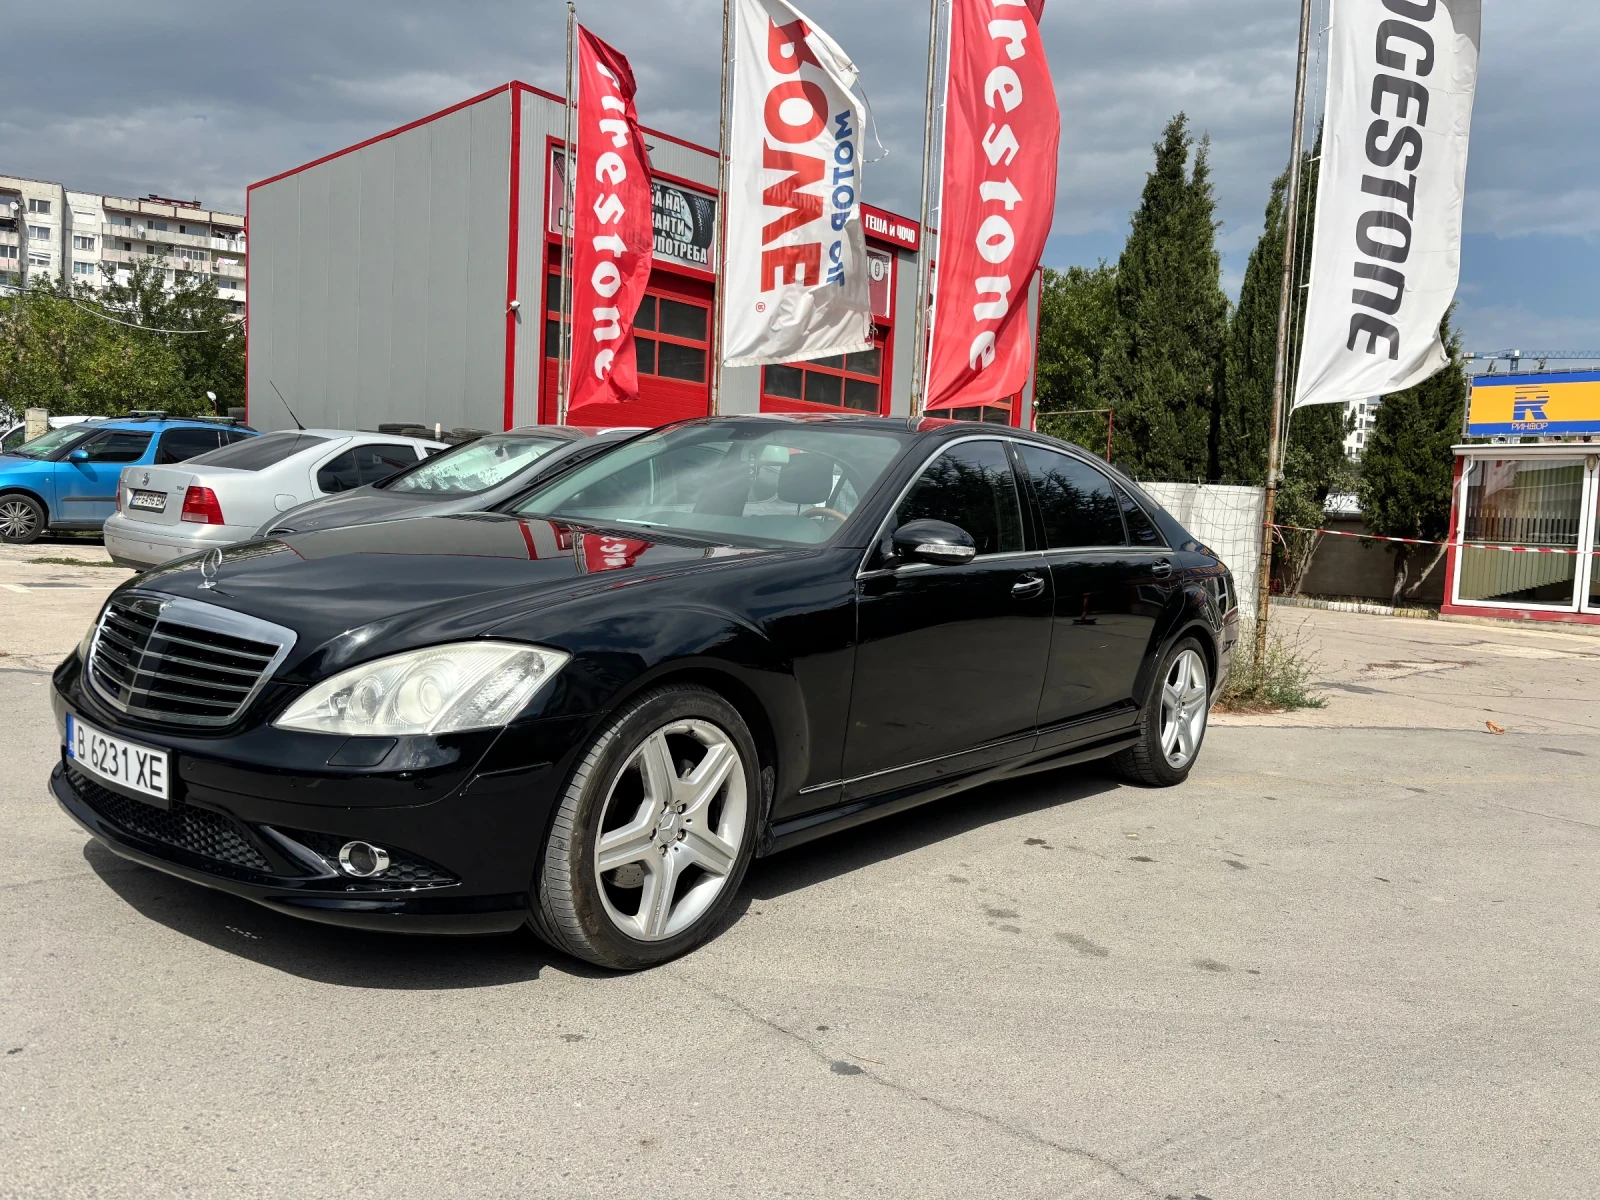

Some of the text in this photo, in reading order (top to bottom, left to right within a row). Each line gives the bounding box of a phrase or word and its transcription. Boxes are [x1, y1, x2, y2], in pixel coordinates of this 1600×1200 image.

[665, 191, 681, 213] НА
[865, 213, 887, 234] ГЕША
[896, 224, 915, 243] ЧОЧО
[78, 725, 163, 793] B 6231 XE
